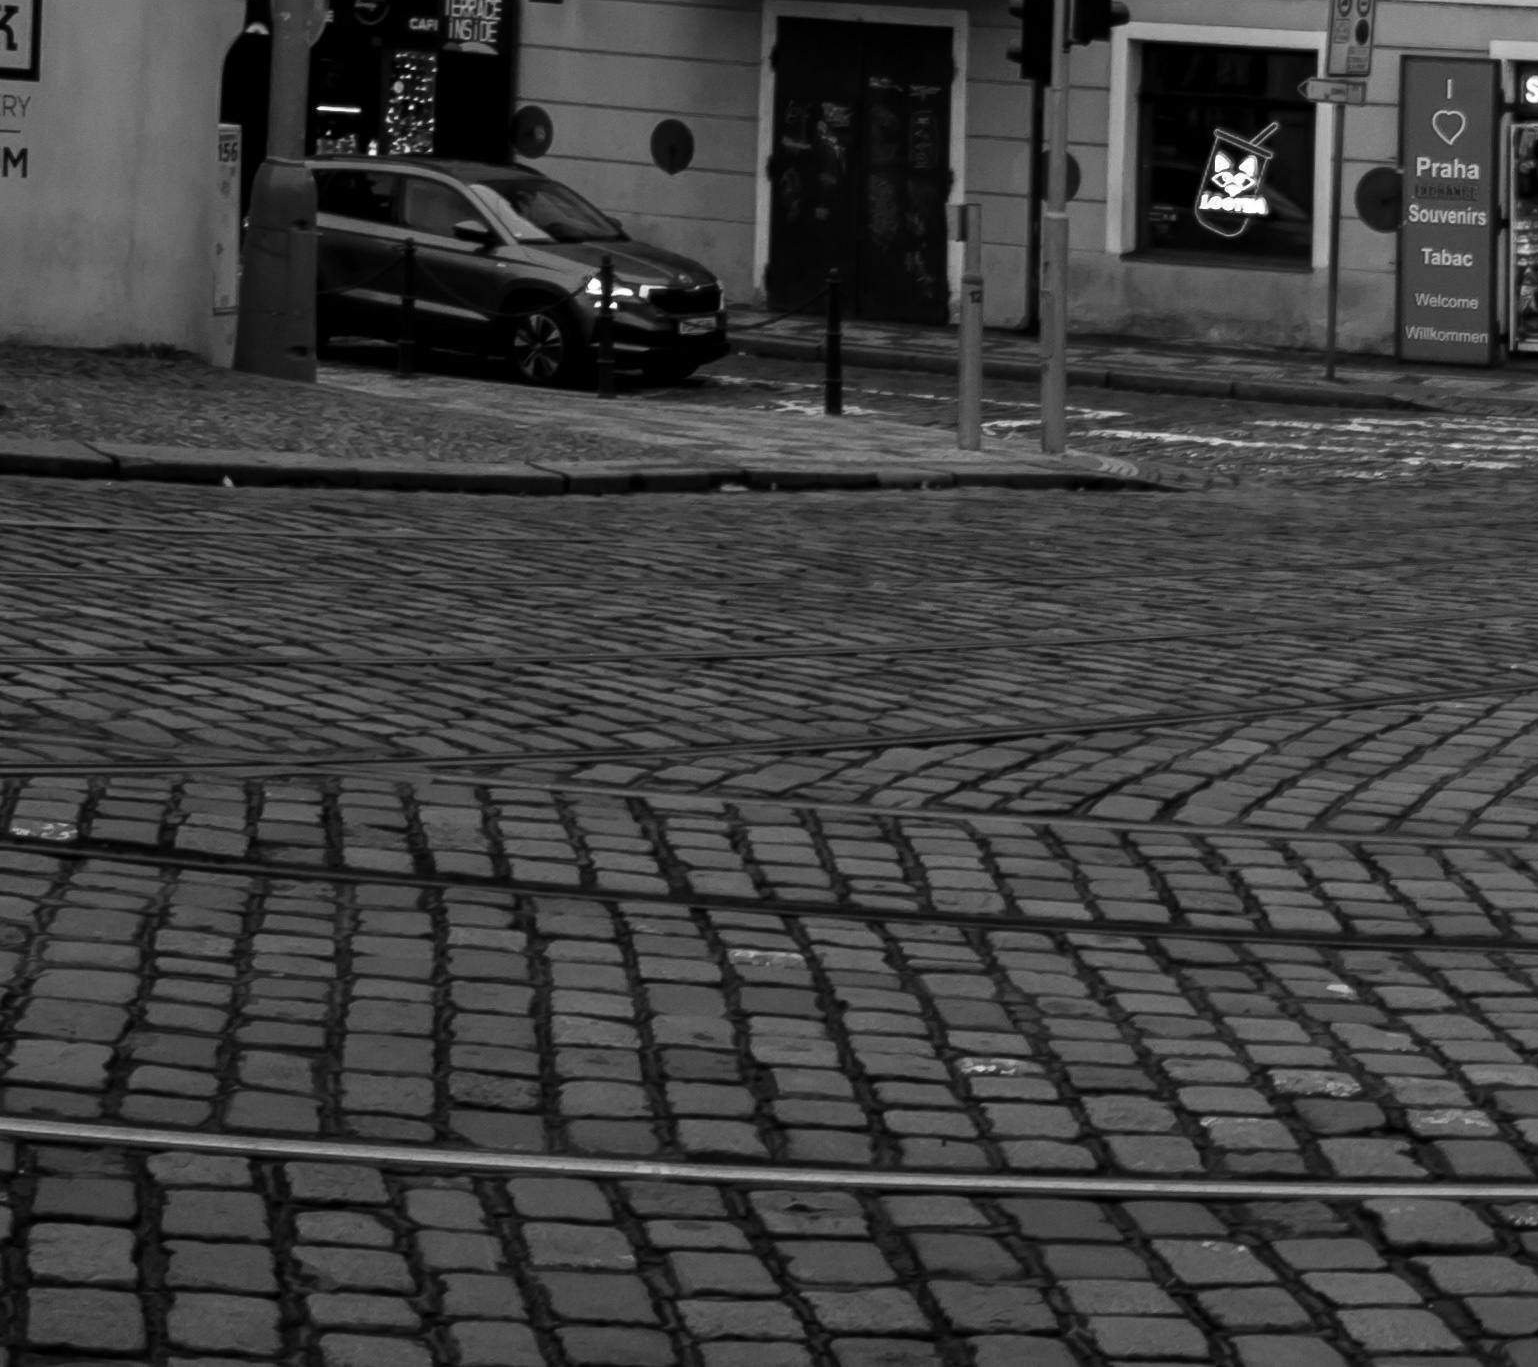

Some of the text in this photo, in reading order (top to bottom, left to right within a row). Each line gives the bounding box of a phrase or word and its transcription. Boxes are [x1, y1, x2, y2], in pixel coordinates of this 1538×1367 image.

[1416, 156, 1480, 179] Praha
[1409, 204, 1487, 226] Souvenirs
[1421, 248, 1473, 267] Tabac
[1415, 293, 1479, 309] Welcome
[1406, 326, 1488, 344] Willkommen
